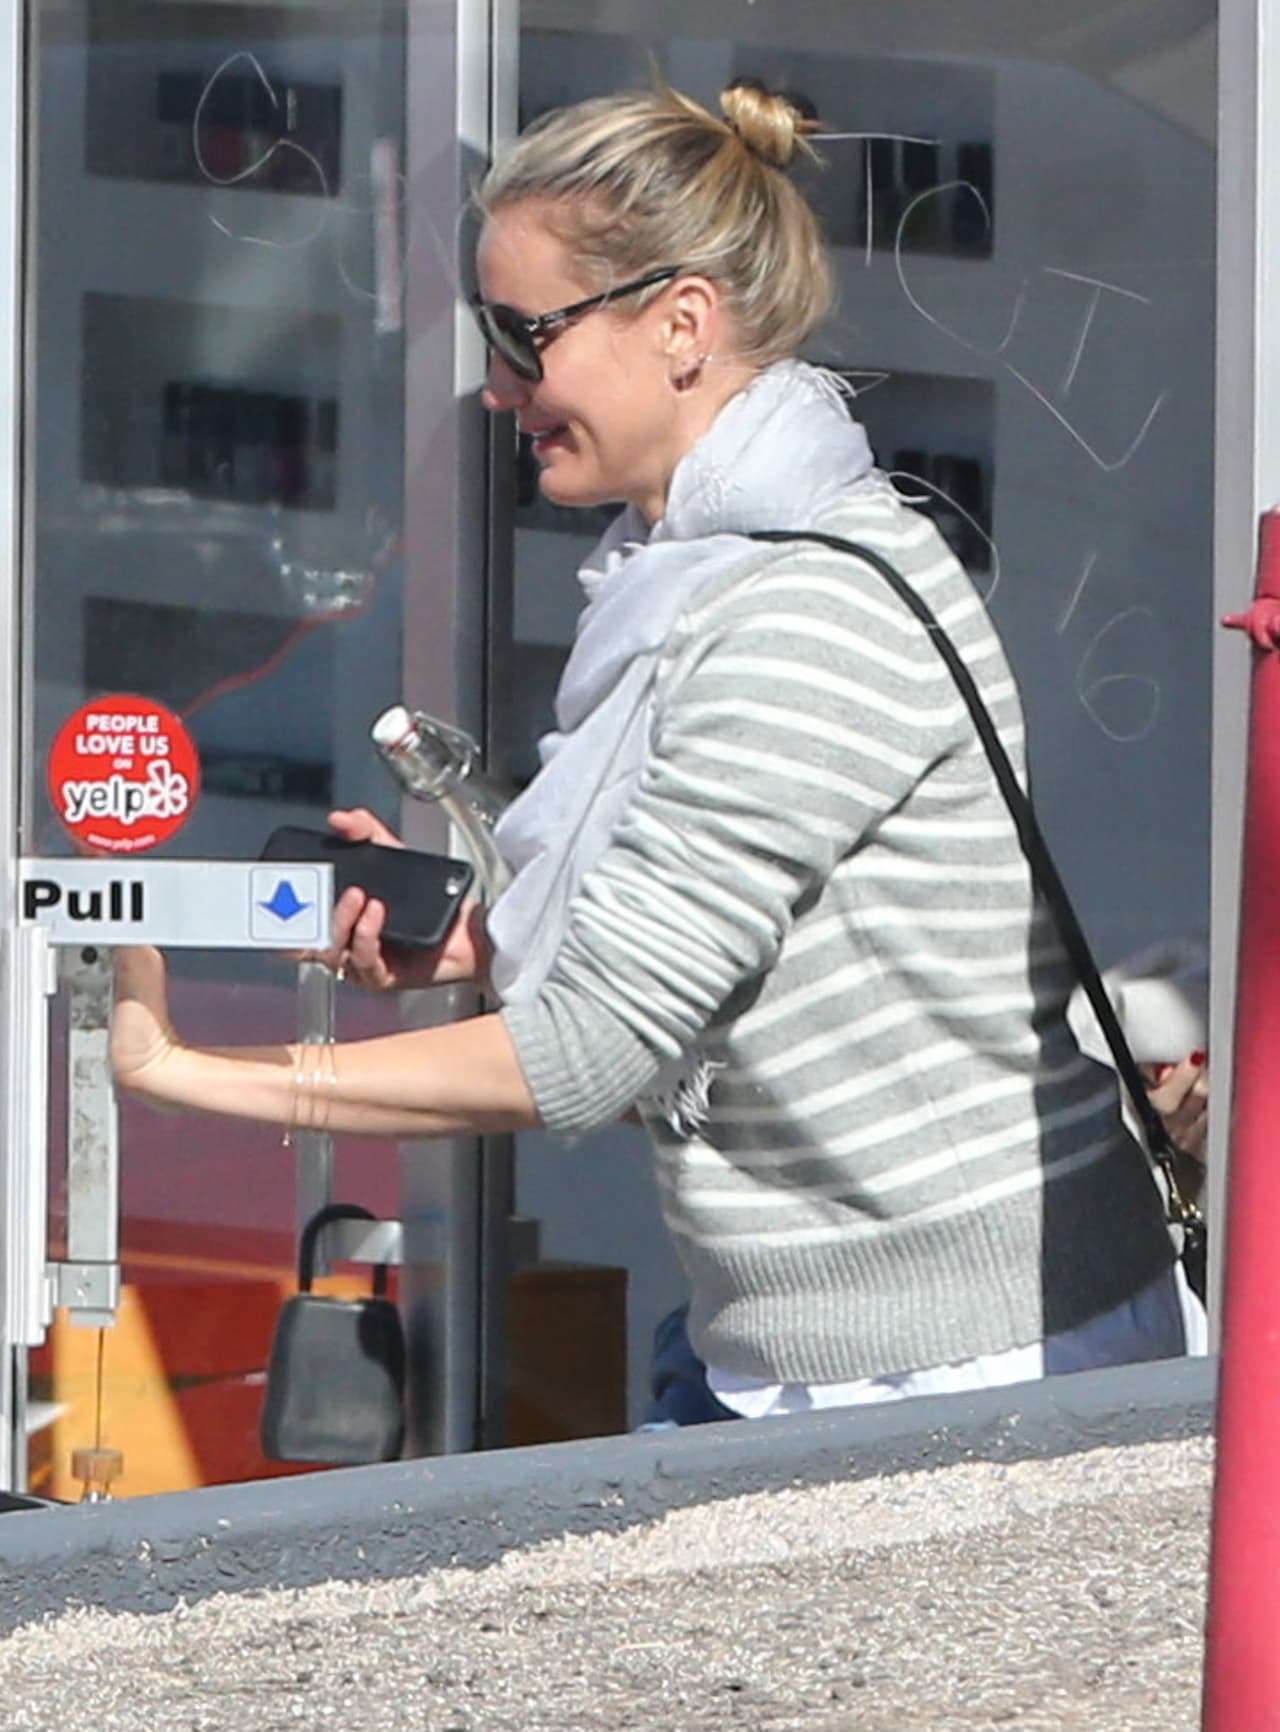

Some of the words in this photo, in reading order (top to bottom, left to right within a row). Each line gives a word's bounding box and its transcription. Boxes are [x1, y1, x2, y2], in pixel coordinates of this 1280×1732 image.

[86, 714, 159, 733] PEOPLE
[76, 734, 135, 755] LOVE
[140, 736, 169, 756] US
[112, 758, 133, 769] ON
[65, 778, 146, 821] yelp
[23, 880, 144, 922] Pull
